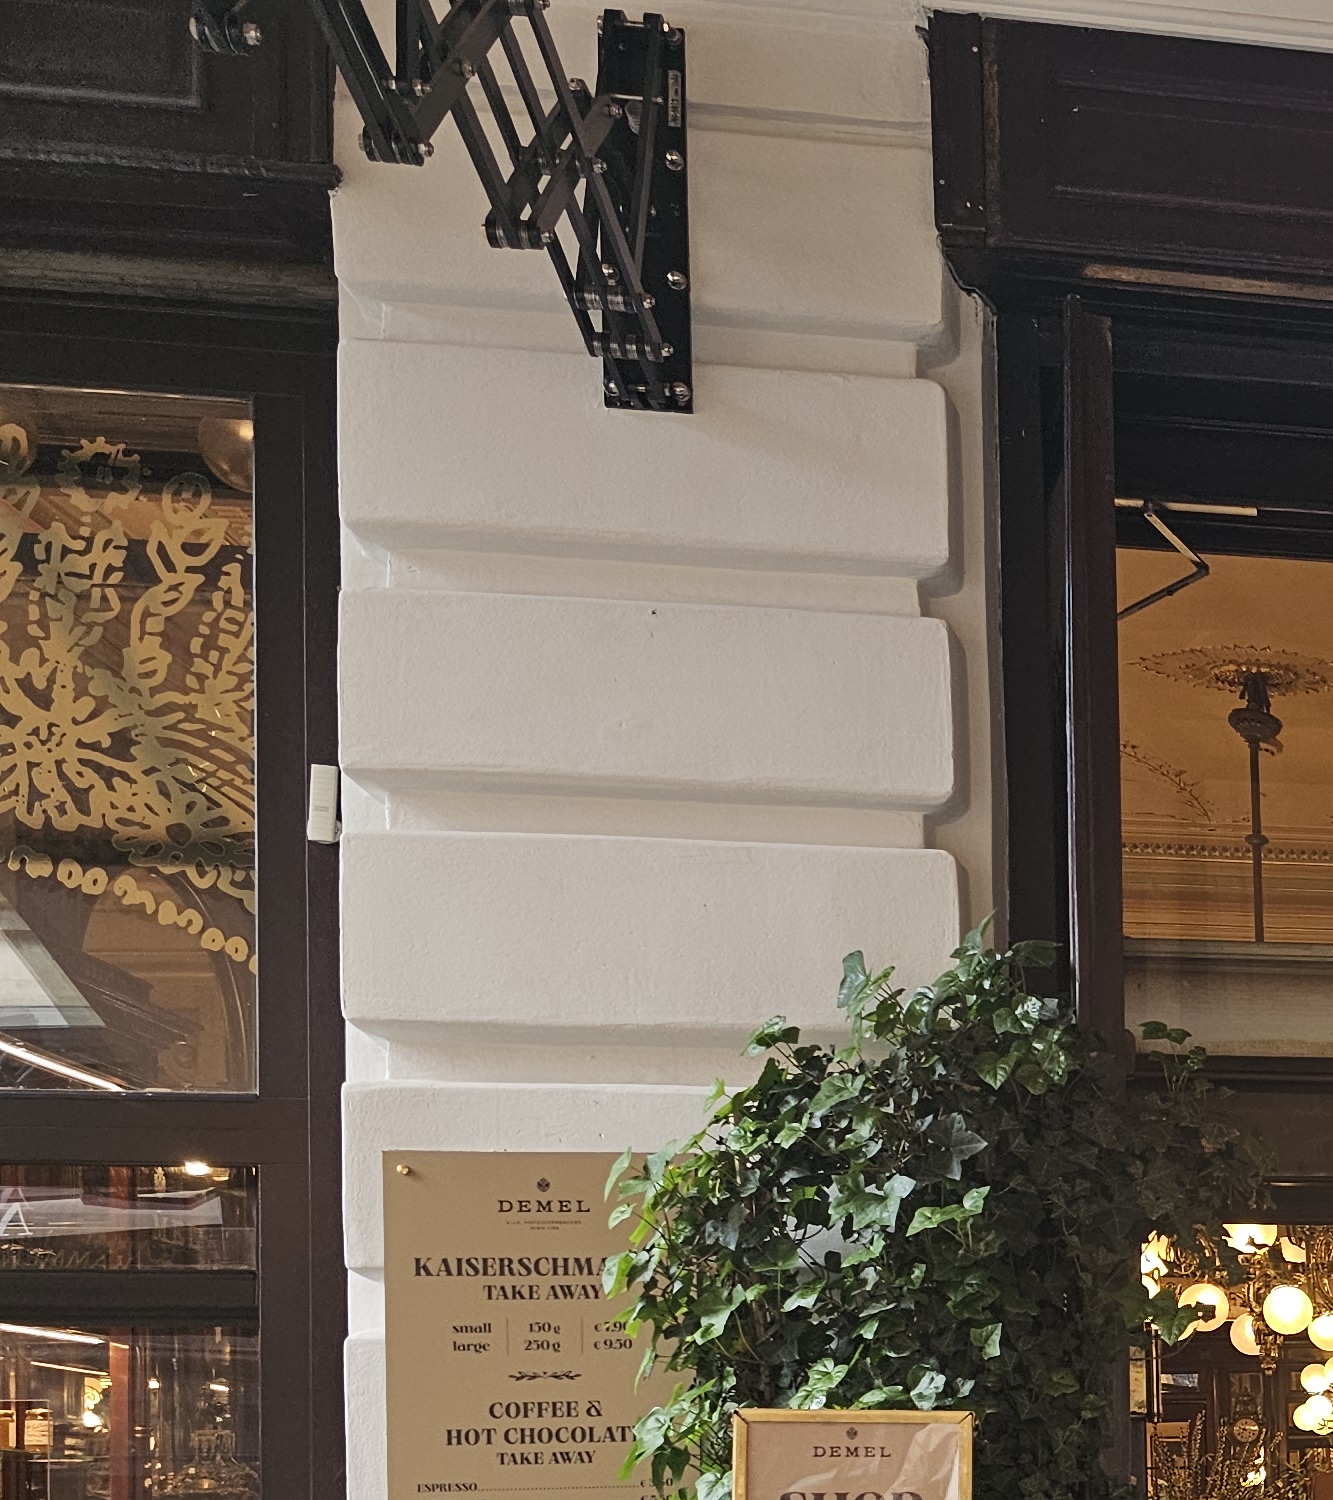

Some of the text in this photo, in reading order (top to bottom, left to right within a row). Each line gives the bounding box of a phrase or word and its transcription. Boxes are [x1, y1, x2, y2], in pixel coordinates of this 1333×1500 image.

[497, 1200, 591, 1213] DEMEL
[483, 1284, 604, 1300] TAKE AWAY
[452, 1322, 492, 1334] small
[529, 1321, 551, 1333] 150
[453, 1341, 490, 1354] large
[524, 1339, 550, 1351] 250
[552, 1342, 561, 1354] g
[489, 1400, 603, 1419] COFFEE &
[446, 1427, 497, 1446] HOT
[497, 1450, 596, 1466] TAKE AWAY
[813, 1446, 891, 1458] DEMEL
[417, 1482, 478, 1493] ESPRESSO
